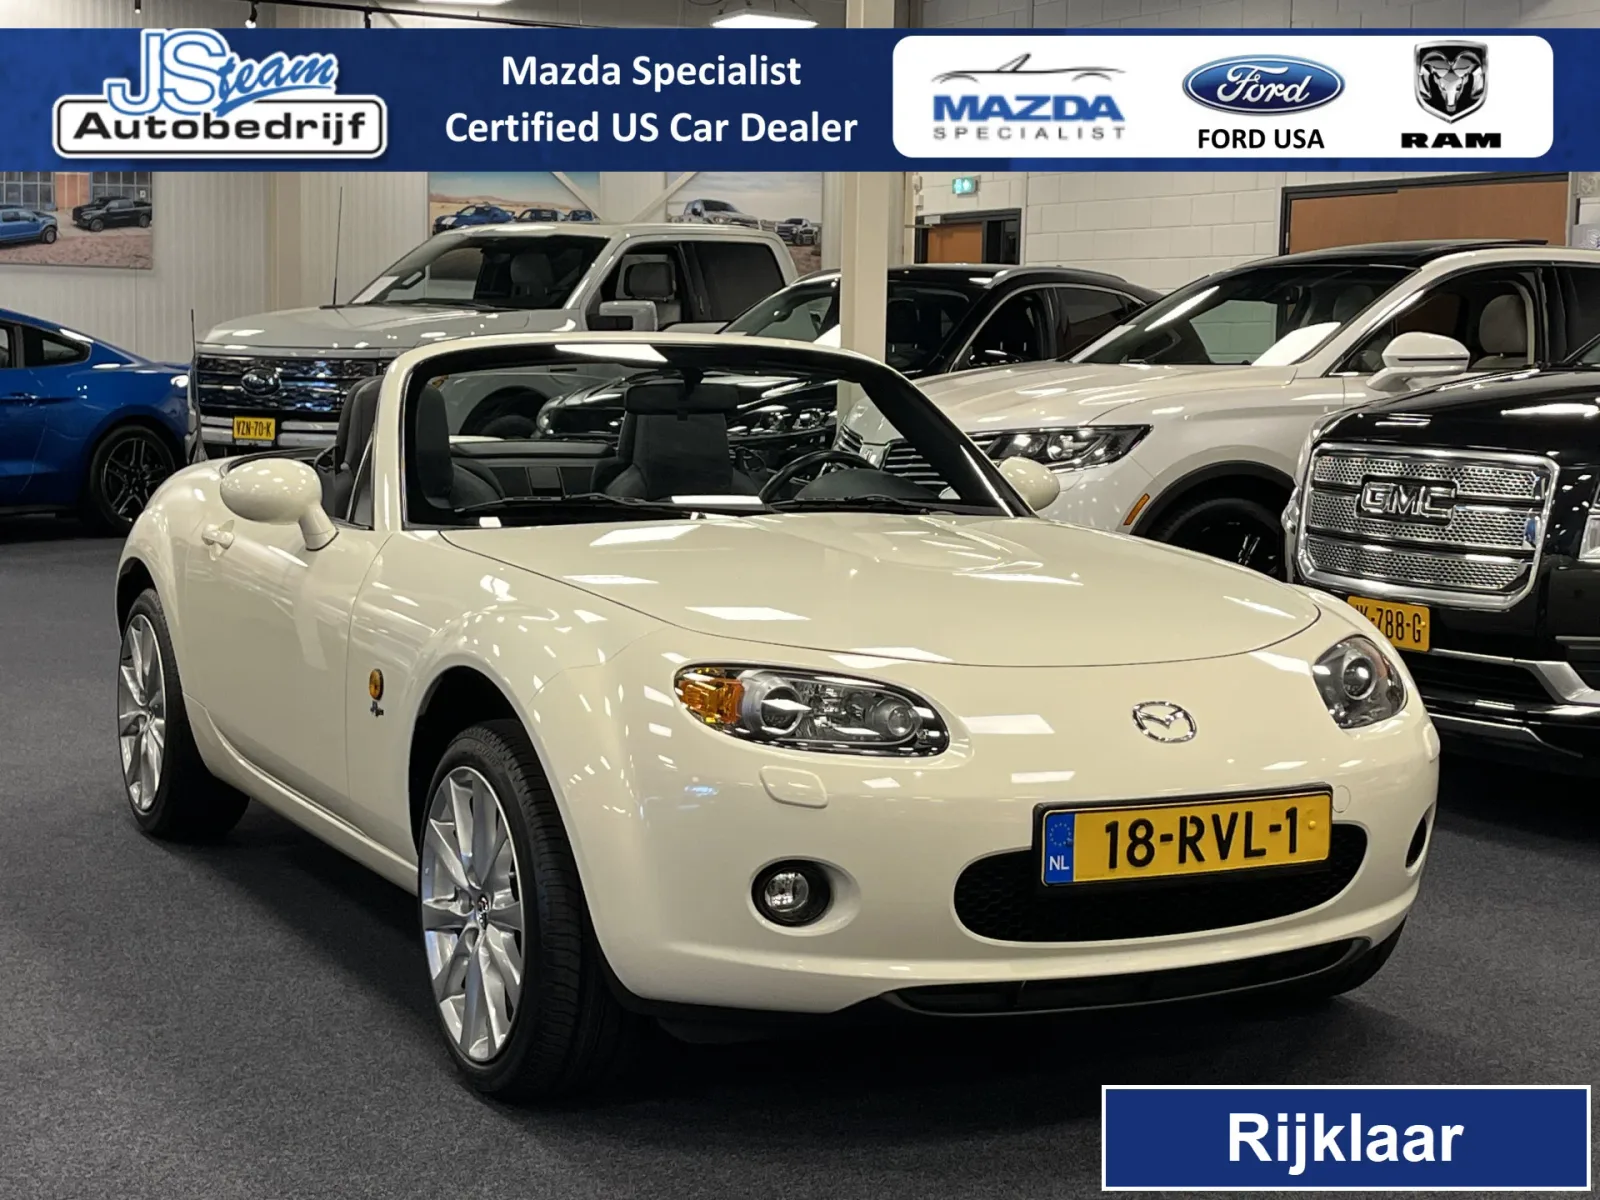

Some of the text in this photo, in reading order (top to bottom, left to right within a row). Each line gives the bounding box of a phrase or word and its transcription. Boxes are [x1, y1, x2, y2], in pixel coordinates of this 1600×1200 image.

[1361, 481, 1456, 518] GMC
[1104, 806, 1299, 870] 18-RVL-1
[1049, 855, 1070, 871] NL
